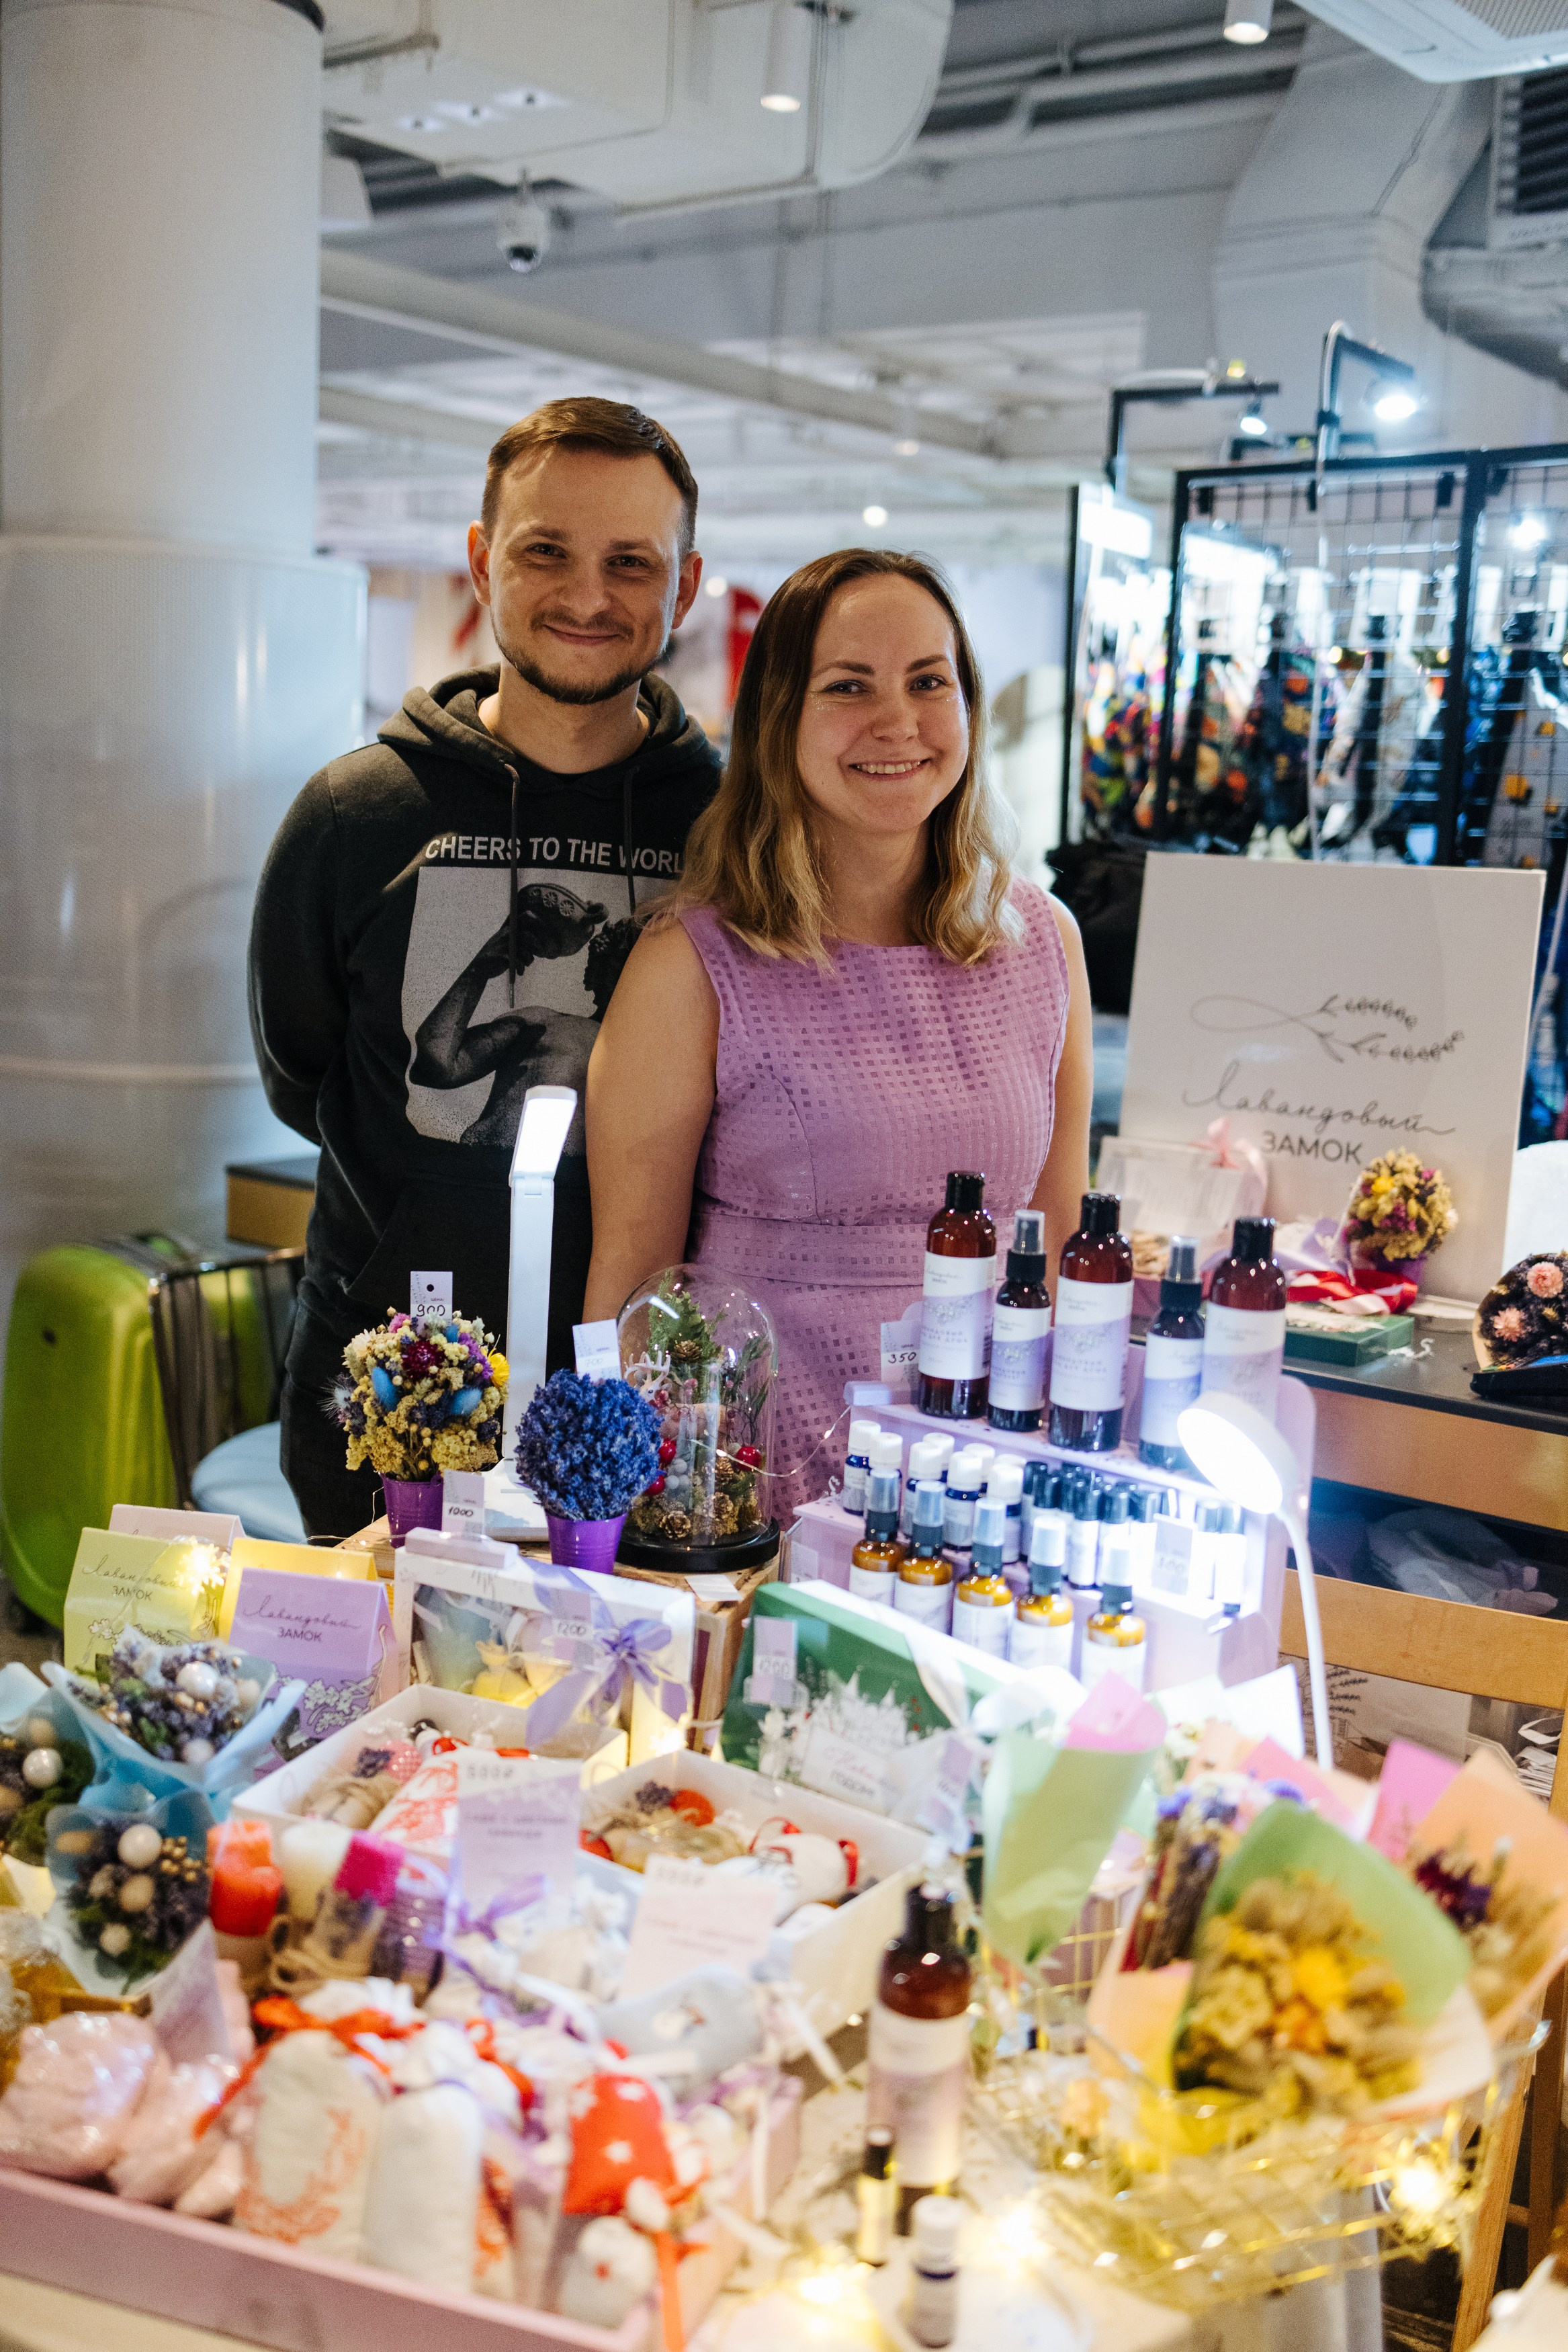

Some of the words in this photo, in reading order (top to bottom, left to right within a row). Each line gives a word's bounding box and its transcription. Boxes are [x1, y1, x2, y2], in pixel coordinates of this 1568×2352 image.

[425, 836, 521, 861] CHEERS
[529, 837, 560, 861] TO
[568, 838, 612, 866] THE
[619, 845, 685, 873] WORL
[1182, 1058, 1456, 1136] Лавандовый
[1262, 1130, 1364, 1165] ЗАМОК
[416, 1304, 445, 1317] 900
[887, 1352, 917, 1364] 350
[449, 1507, 474, 1517] 1000
[112, 1585, 153, 1601] ЗАМОК
[243, 1595, 362, 1630] Лавандовый
[278, 1626, 322, 1643] ЗАМОК
